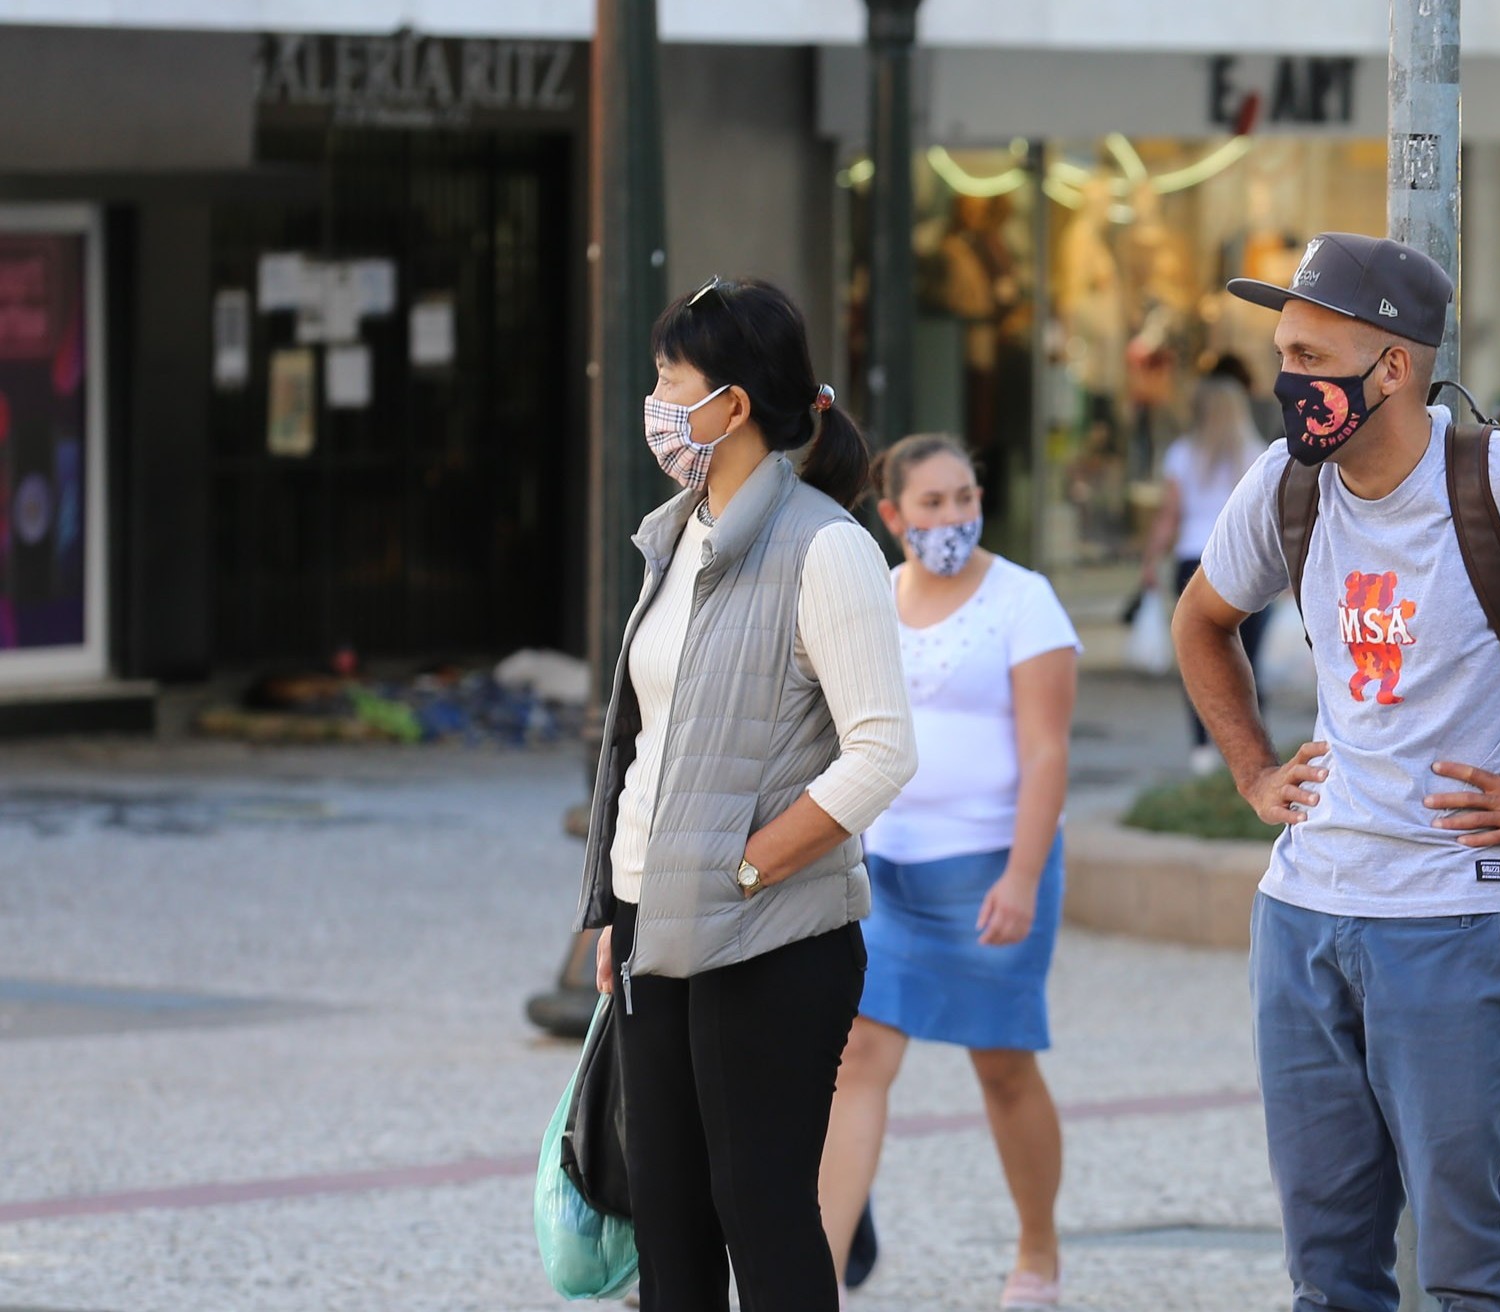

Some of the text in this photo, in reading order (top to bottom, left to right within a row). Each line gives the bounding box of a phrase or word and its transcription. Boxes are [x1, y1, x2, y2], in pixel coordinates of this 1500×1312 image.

[252, 28, 575, 108] ALERÍA RITZ
[1271, 55, 1360, 126] ART
[1301, 432, 1315, 446] EL
[1338, 606, 1415, 645] MSA
